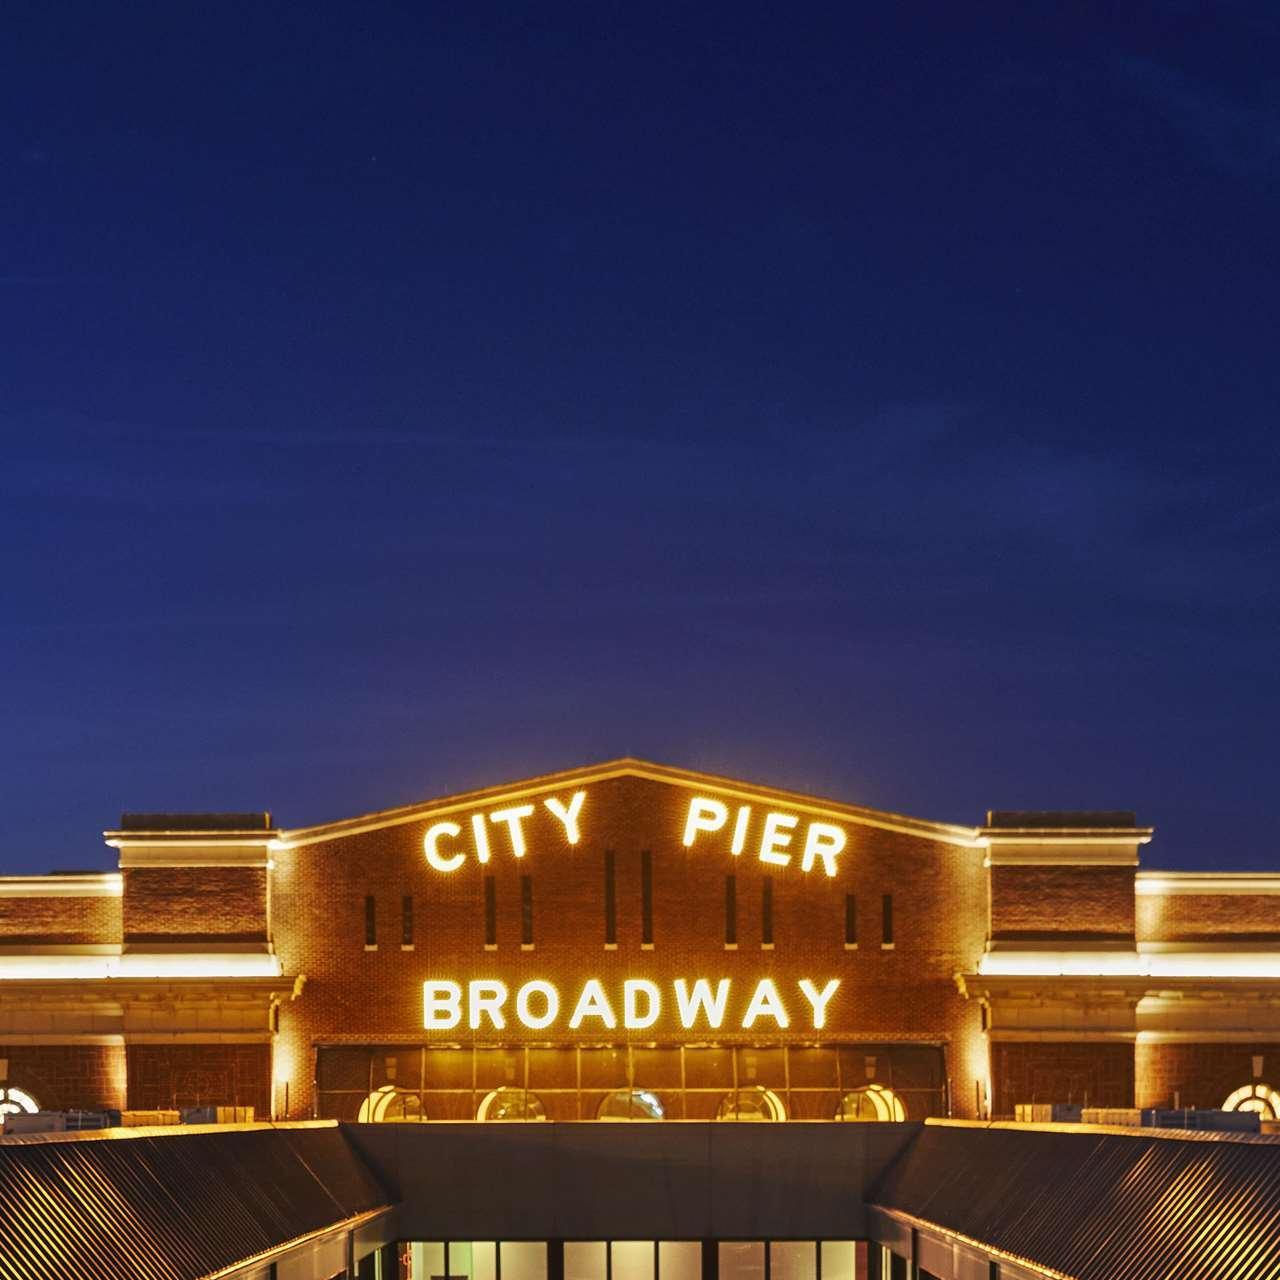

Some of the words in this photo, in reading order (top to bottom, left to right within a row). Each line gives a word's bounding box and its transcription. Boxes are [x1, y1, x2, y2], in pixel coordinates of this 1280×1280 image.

[424, 792, 585, 872] CITY
[683, 797, 846, 877] PIER
[423, 979, 840, 1030] BROADWAY
